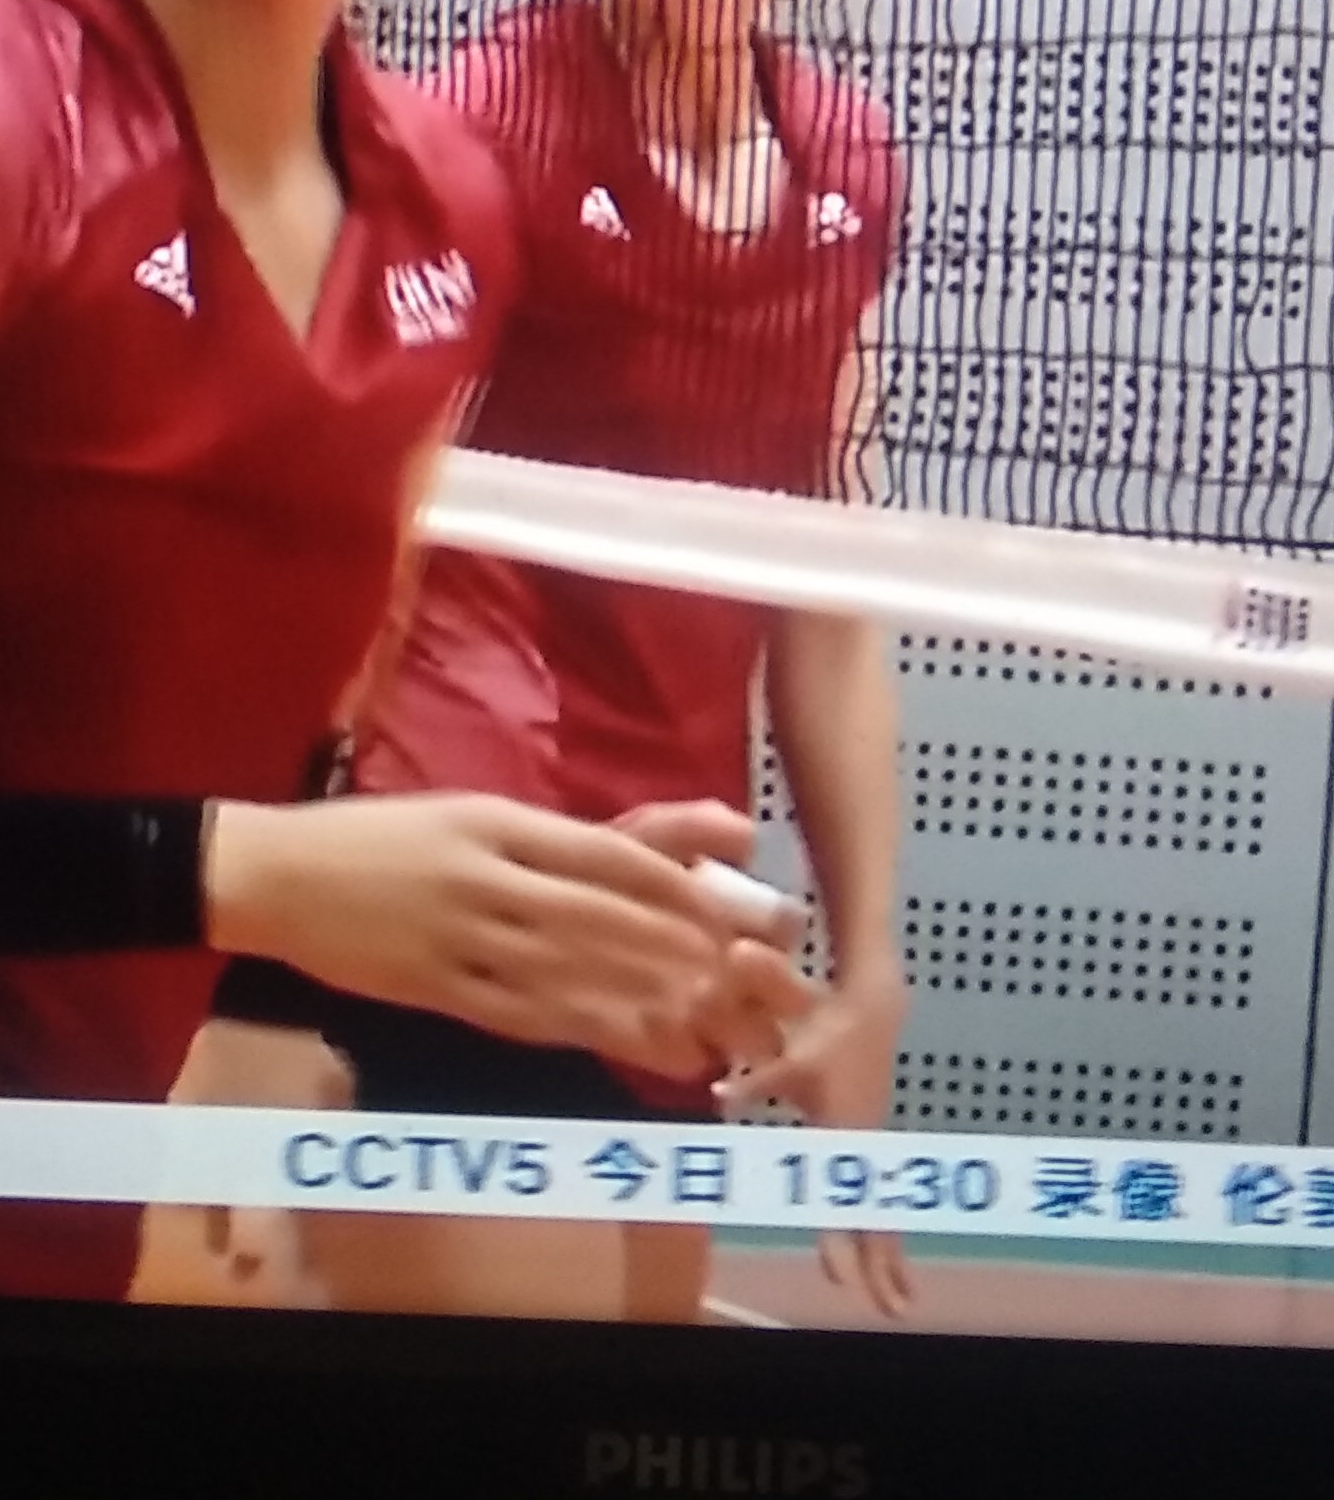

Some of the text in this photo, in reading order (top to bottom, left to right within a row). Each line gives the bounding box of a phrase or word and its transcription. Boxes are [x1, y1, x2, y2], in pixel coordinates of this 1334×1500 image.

[284, 1132, 553, 1197] CCTV5
[581, 1137, 733, 1206] 今日
[779, 1151, 1001, 1214] 19:30
[1029, 1155, 1190, 1222] 录像
[584, 1429, 869, 1499] PHILIPS
